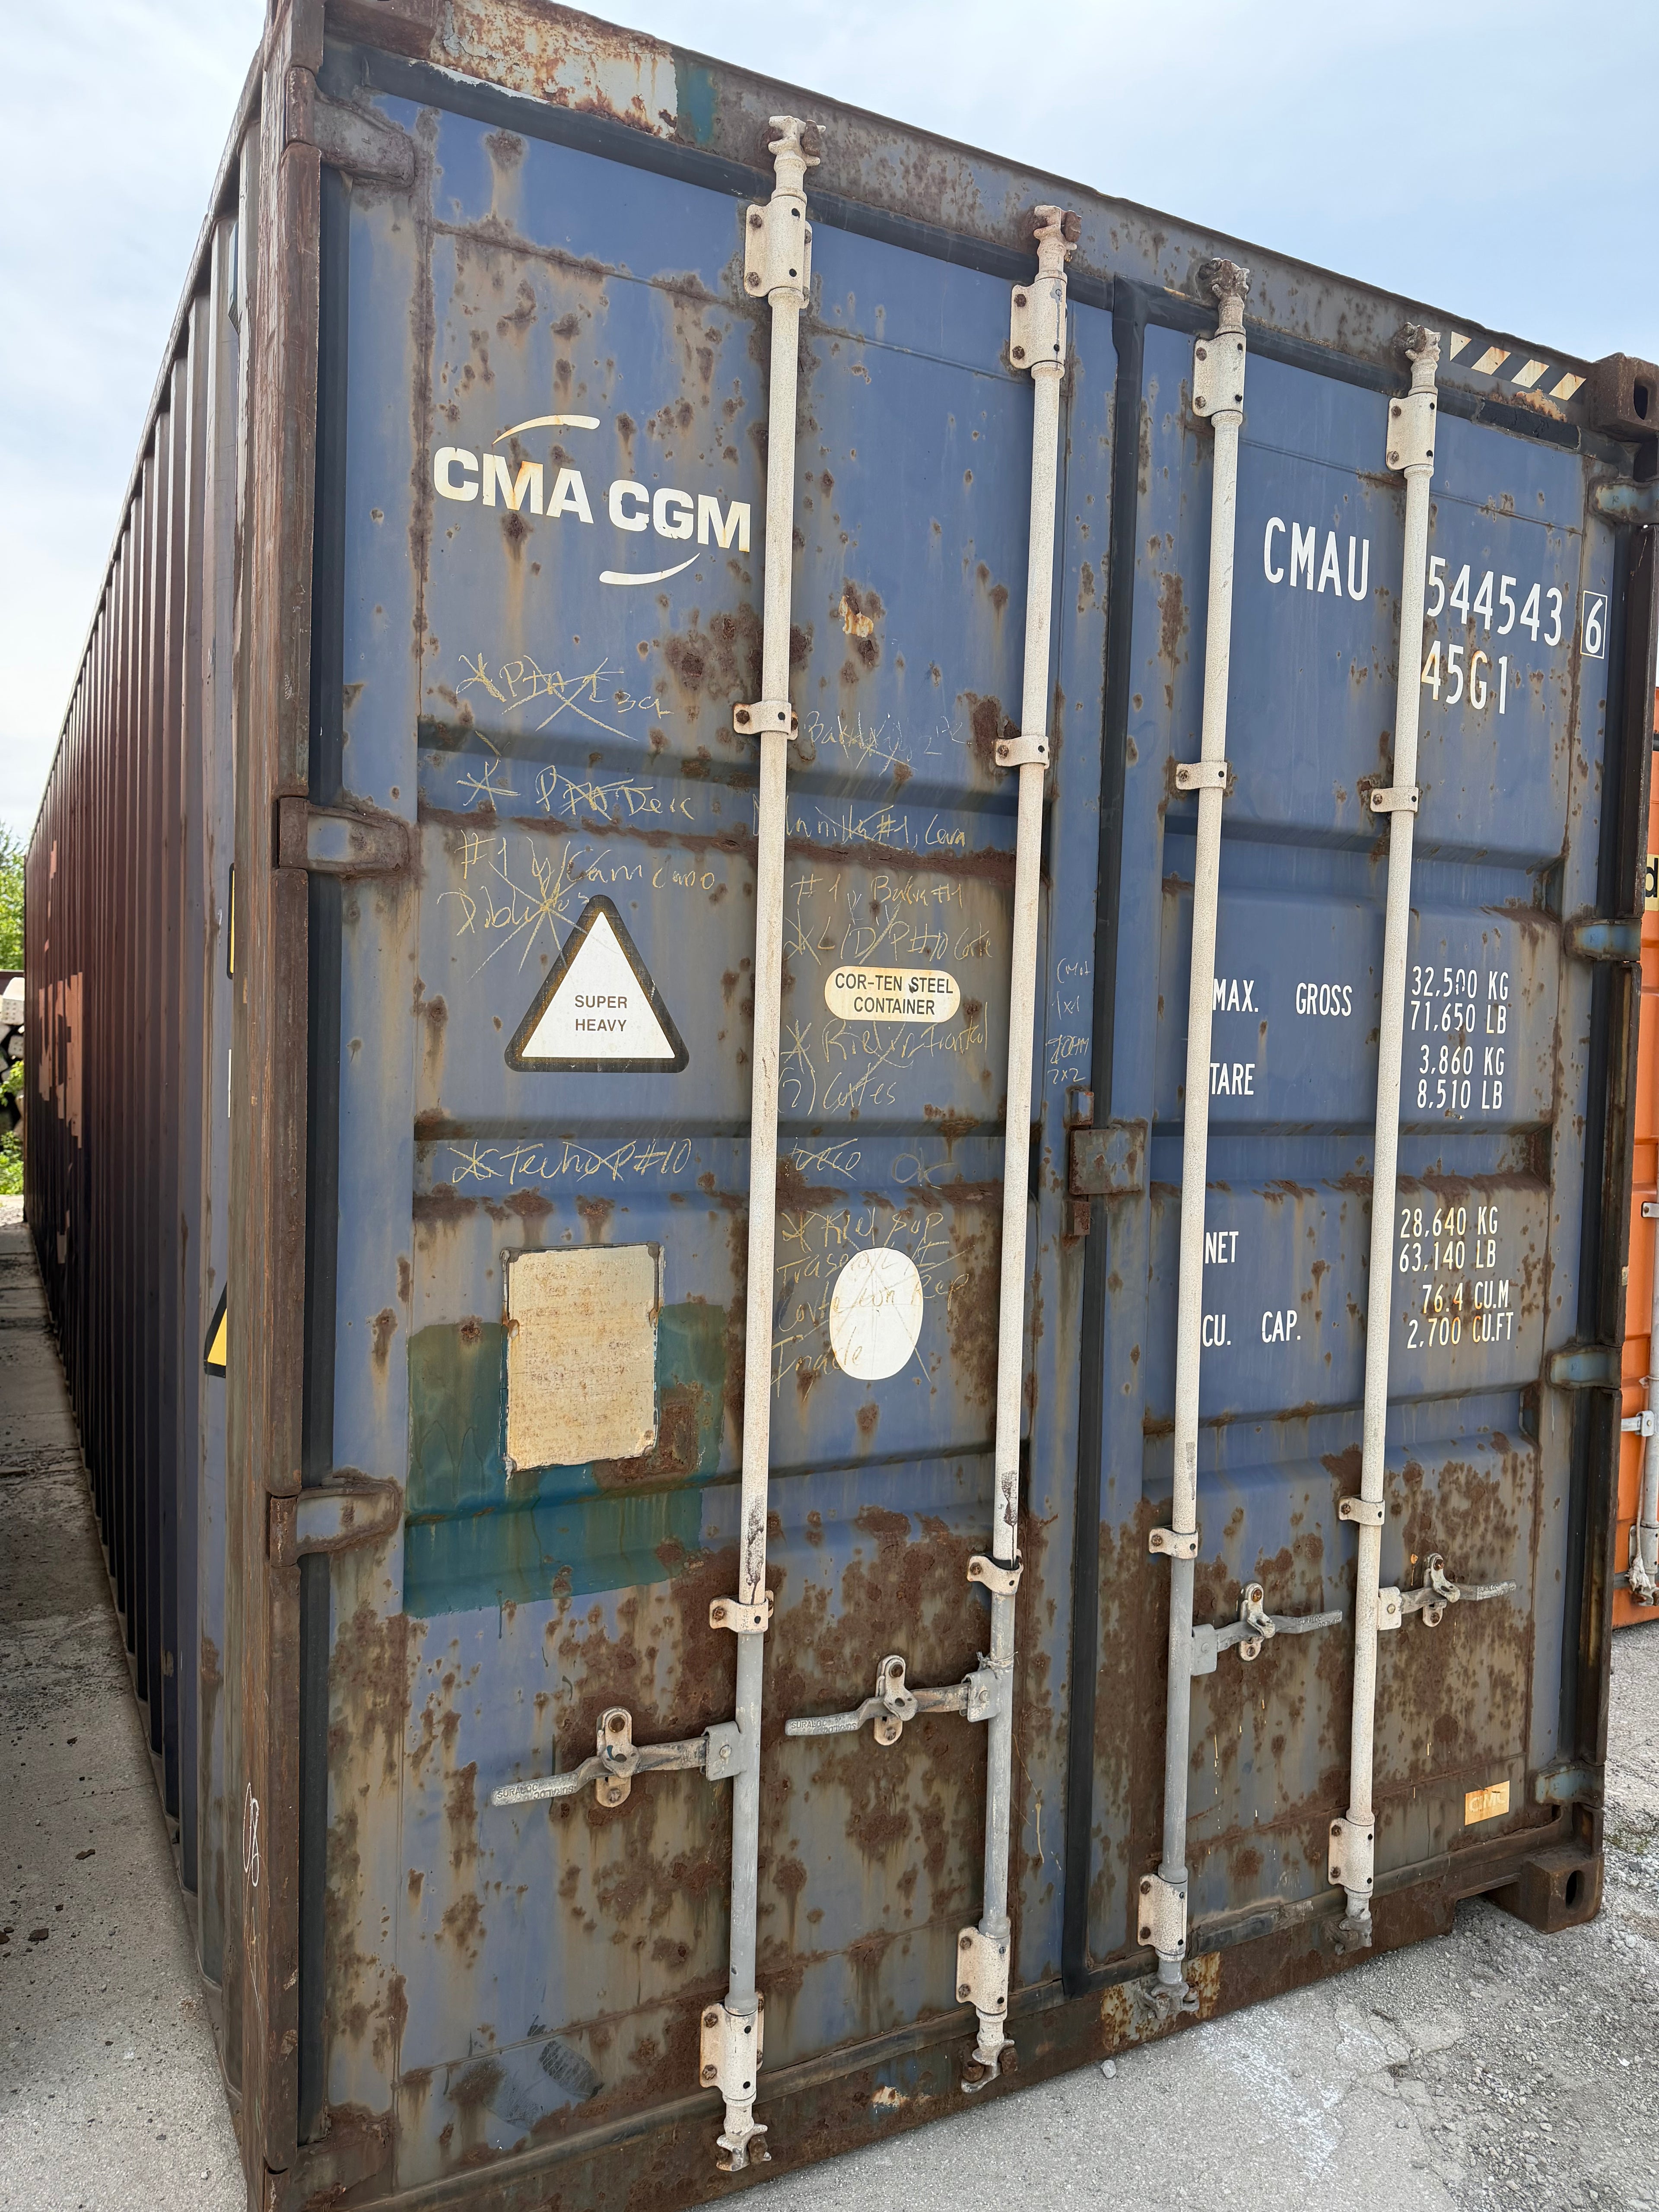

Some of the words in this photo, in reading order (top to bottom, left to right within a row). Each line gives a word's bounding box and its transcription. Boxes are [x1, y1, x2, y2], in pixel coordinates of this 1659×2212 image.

[434, 446, 594, 524] CMA
[609, 480, 751, 553] CGM
[1264, 517, 1369, 601] CMAU
[1426, 555, 1563, 646] 544543
[1585, 597, 1603, 654] 6
[1421, 640, 1508, 714] 45G1
[835, 973, 902, 992] COR-TEN
[910, 976, 953, 994] STEEL
[1213, 979, 1259, 1013] MAX.
[1296, 982, 1353, 1017] GROSS
[1411, 966, 1478, 999] 32,500
[1488, 971, 1509, 1001] KG
[575, 995, 628, 1009] SUPER
[854, 997, 935, 1015] CONTAINER
[1411, 1000, 1476, 1033] 71,650
[1486, 1003, 1507, 1034] LB
[575, 1018, 627, 1033] HEAVY
[1419, 1044, 1473, 1076] 3,860
[1484, 1046, 1505, 1076] KG
[1210, 1062, 1255, 1096] TARE
[1417, 1079, 1471, 1110] 8,510
[1482, 1081, 1503, 1110] LB
[1400, 1207, 1467, 1239] 28,640
[1478, 1206, 1498, 1235] KG
[1205, 1231, 1239, 1264] NET
[1399, 1240, 1465, 1272] 63,140
[1476, 1239, 1497, 1269] LB
[1422, 1282, 1463, 1314] 76.4
[1474, 1279, 1509, 1310] CU.M
[1202, 1314, 1231, 1348] CU.
[1262, 1310, 1301, 1343] CAP.
[1407, 1317, 1461, 1350] 2,700
[1472, 1311, 1514, 1343] CU.FT
[791, 1720, 826, 1729] SURALOC
[497, 1783, 538, 1799] SURALOC
